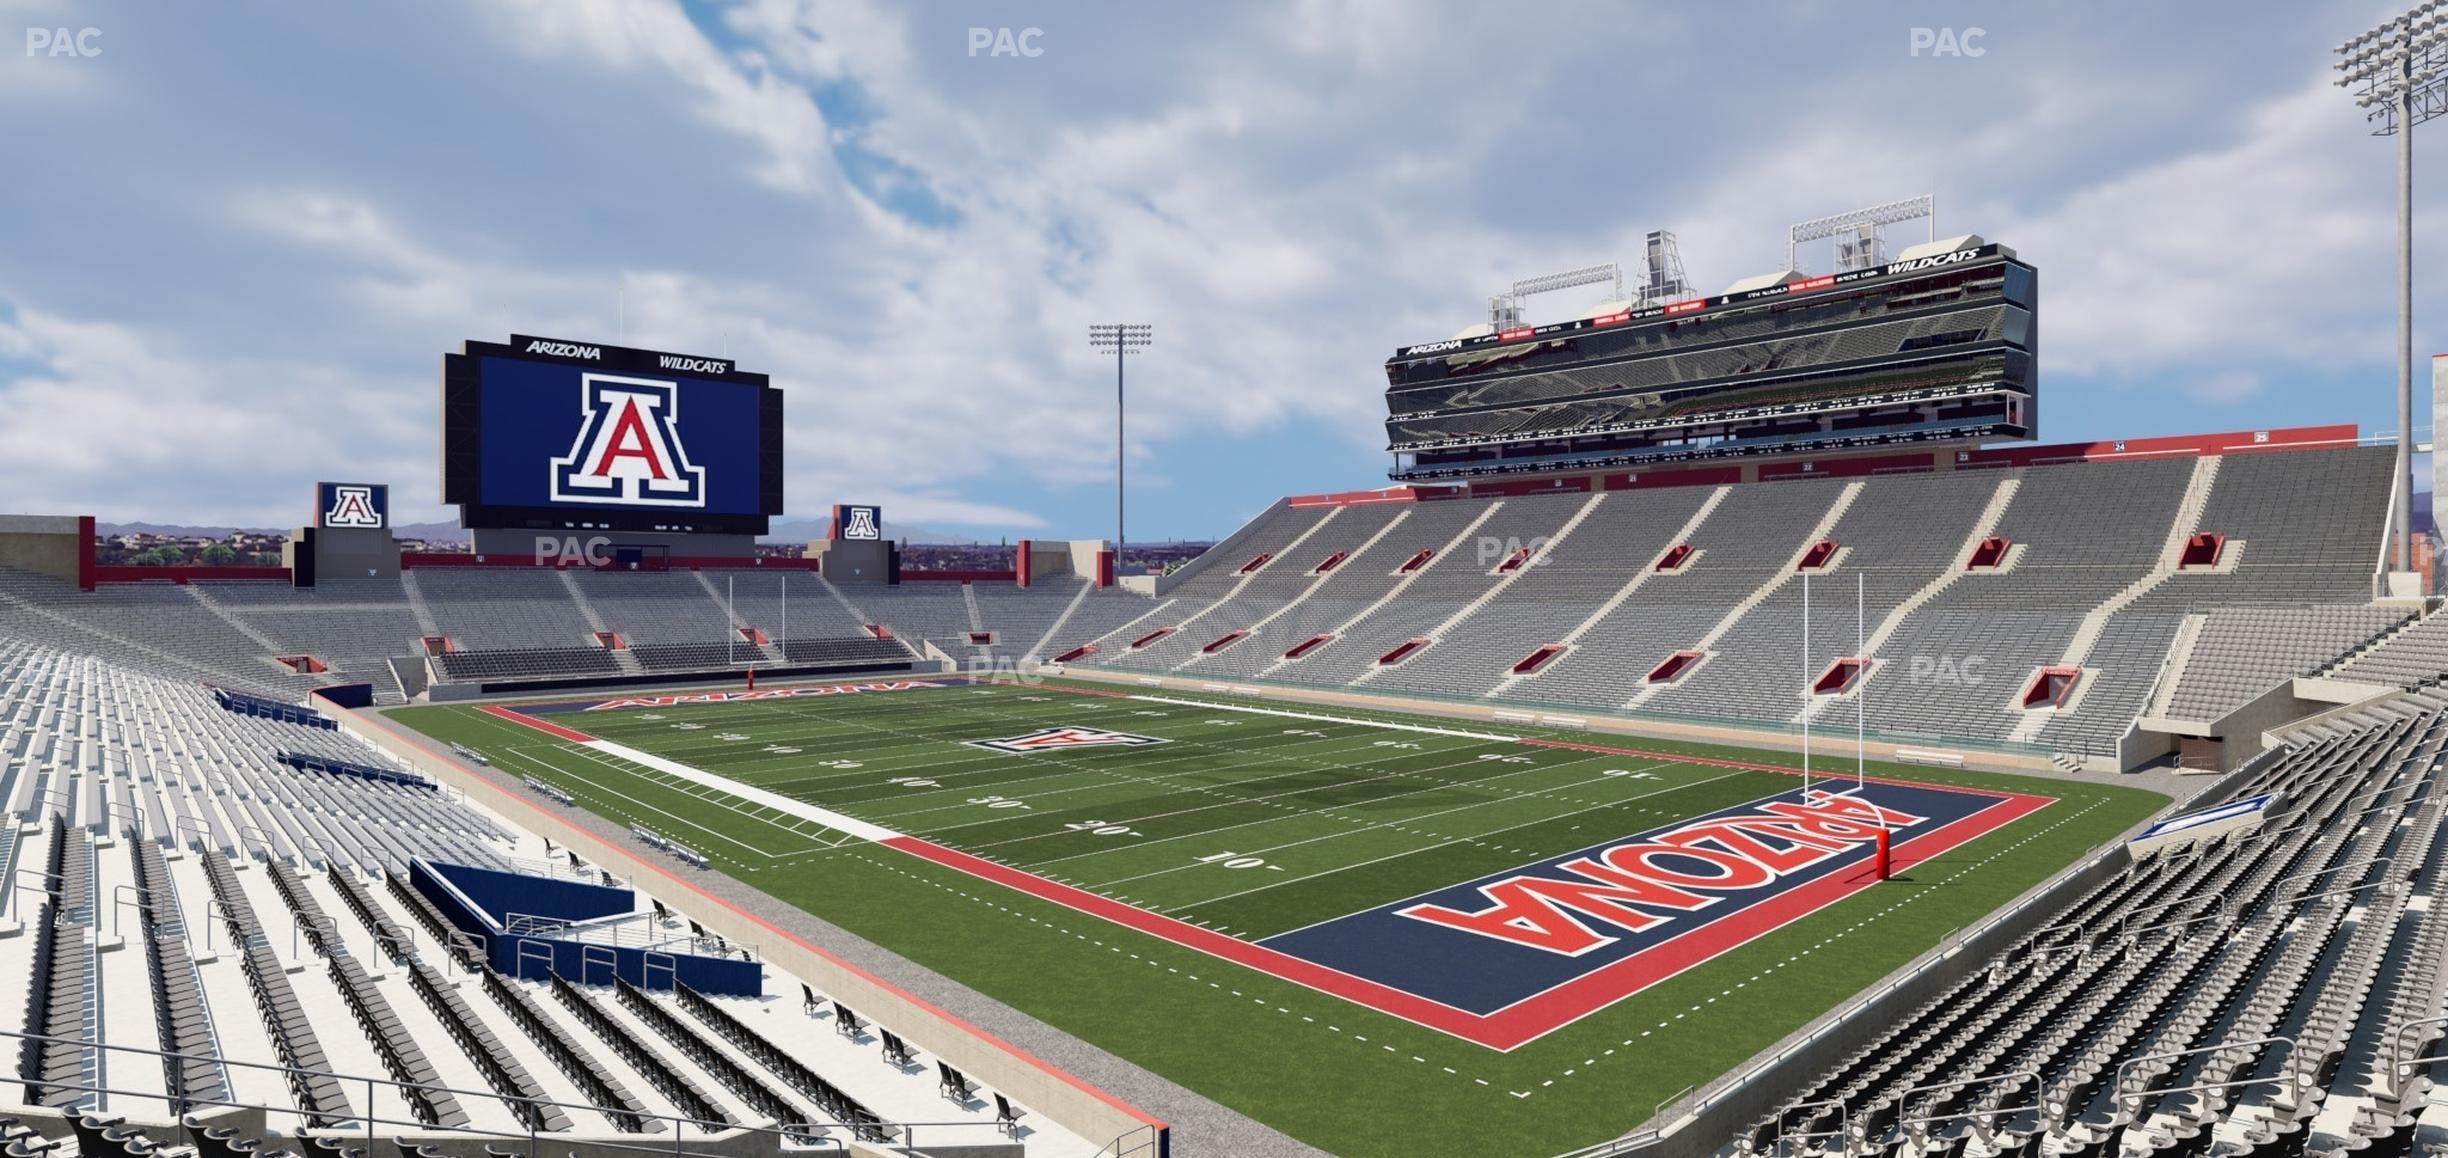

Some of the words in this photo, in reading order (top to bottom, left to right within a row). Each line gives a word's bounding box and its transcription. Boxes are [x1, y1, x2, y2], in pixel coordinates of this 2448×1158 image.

[1887, 247, 1980, 275] WILDCATS
[526, 340, 601, 360] ARIZONA
[659, 355, 727, 374] WILDCATS
[1405, 340, 1462, 355] ARIZONA
[550, 372, 705, 507] A
[325, 486, 382, 528] A
[844, 507, 879, 540] A
[582, 681, 948, 711] ARIZONA
[1064, 820, 1131, 836] 20
[1192, 850, 1265, 869] 10
[1391, 788, 1931, 958] ARIZONA
